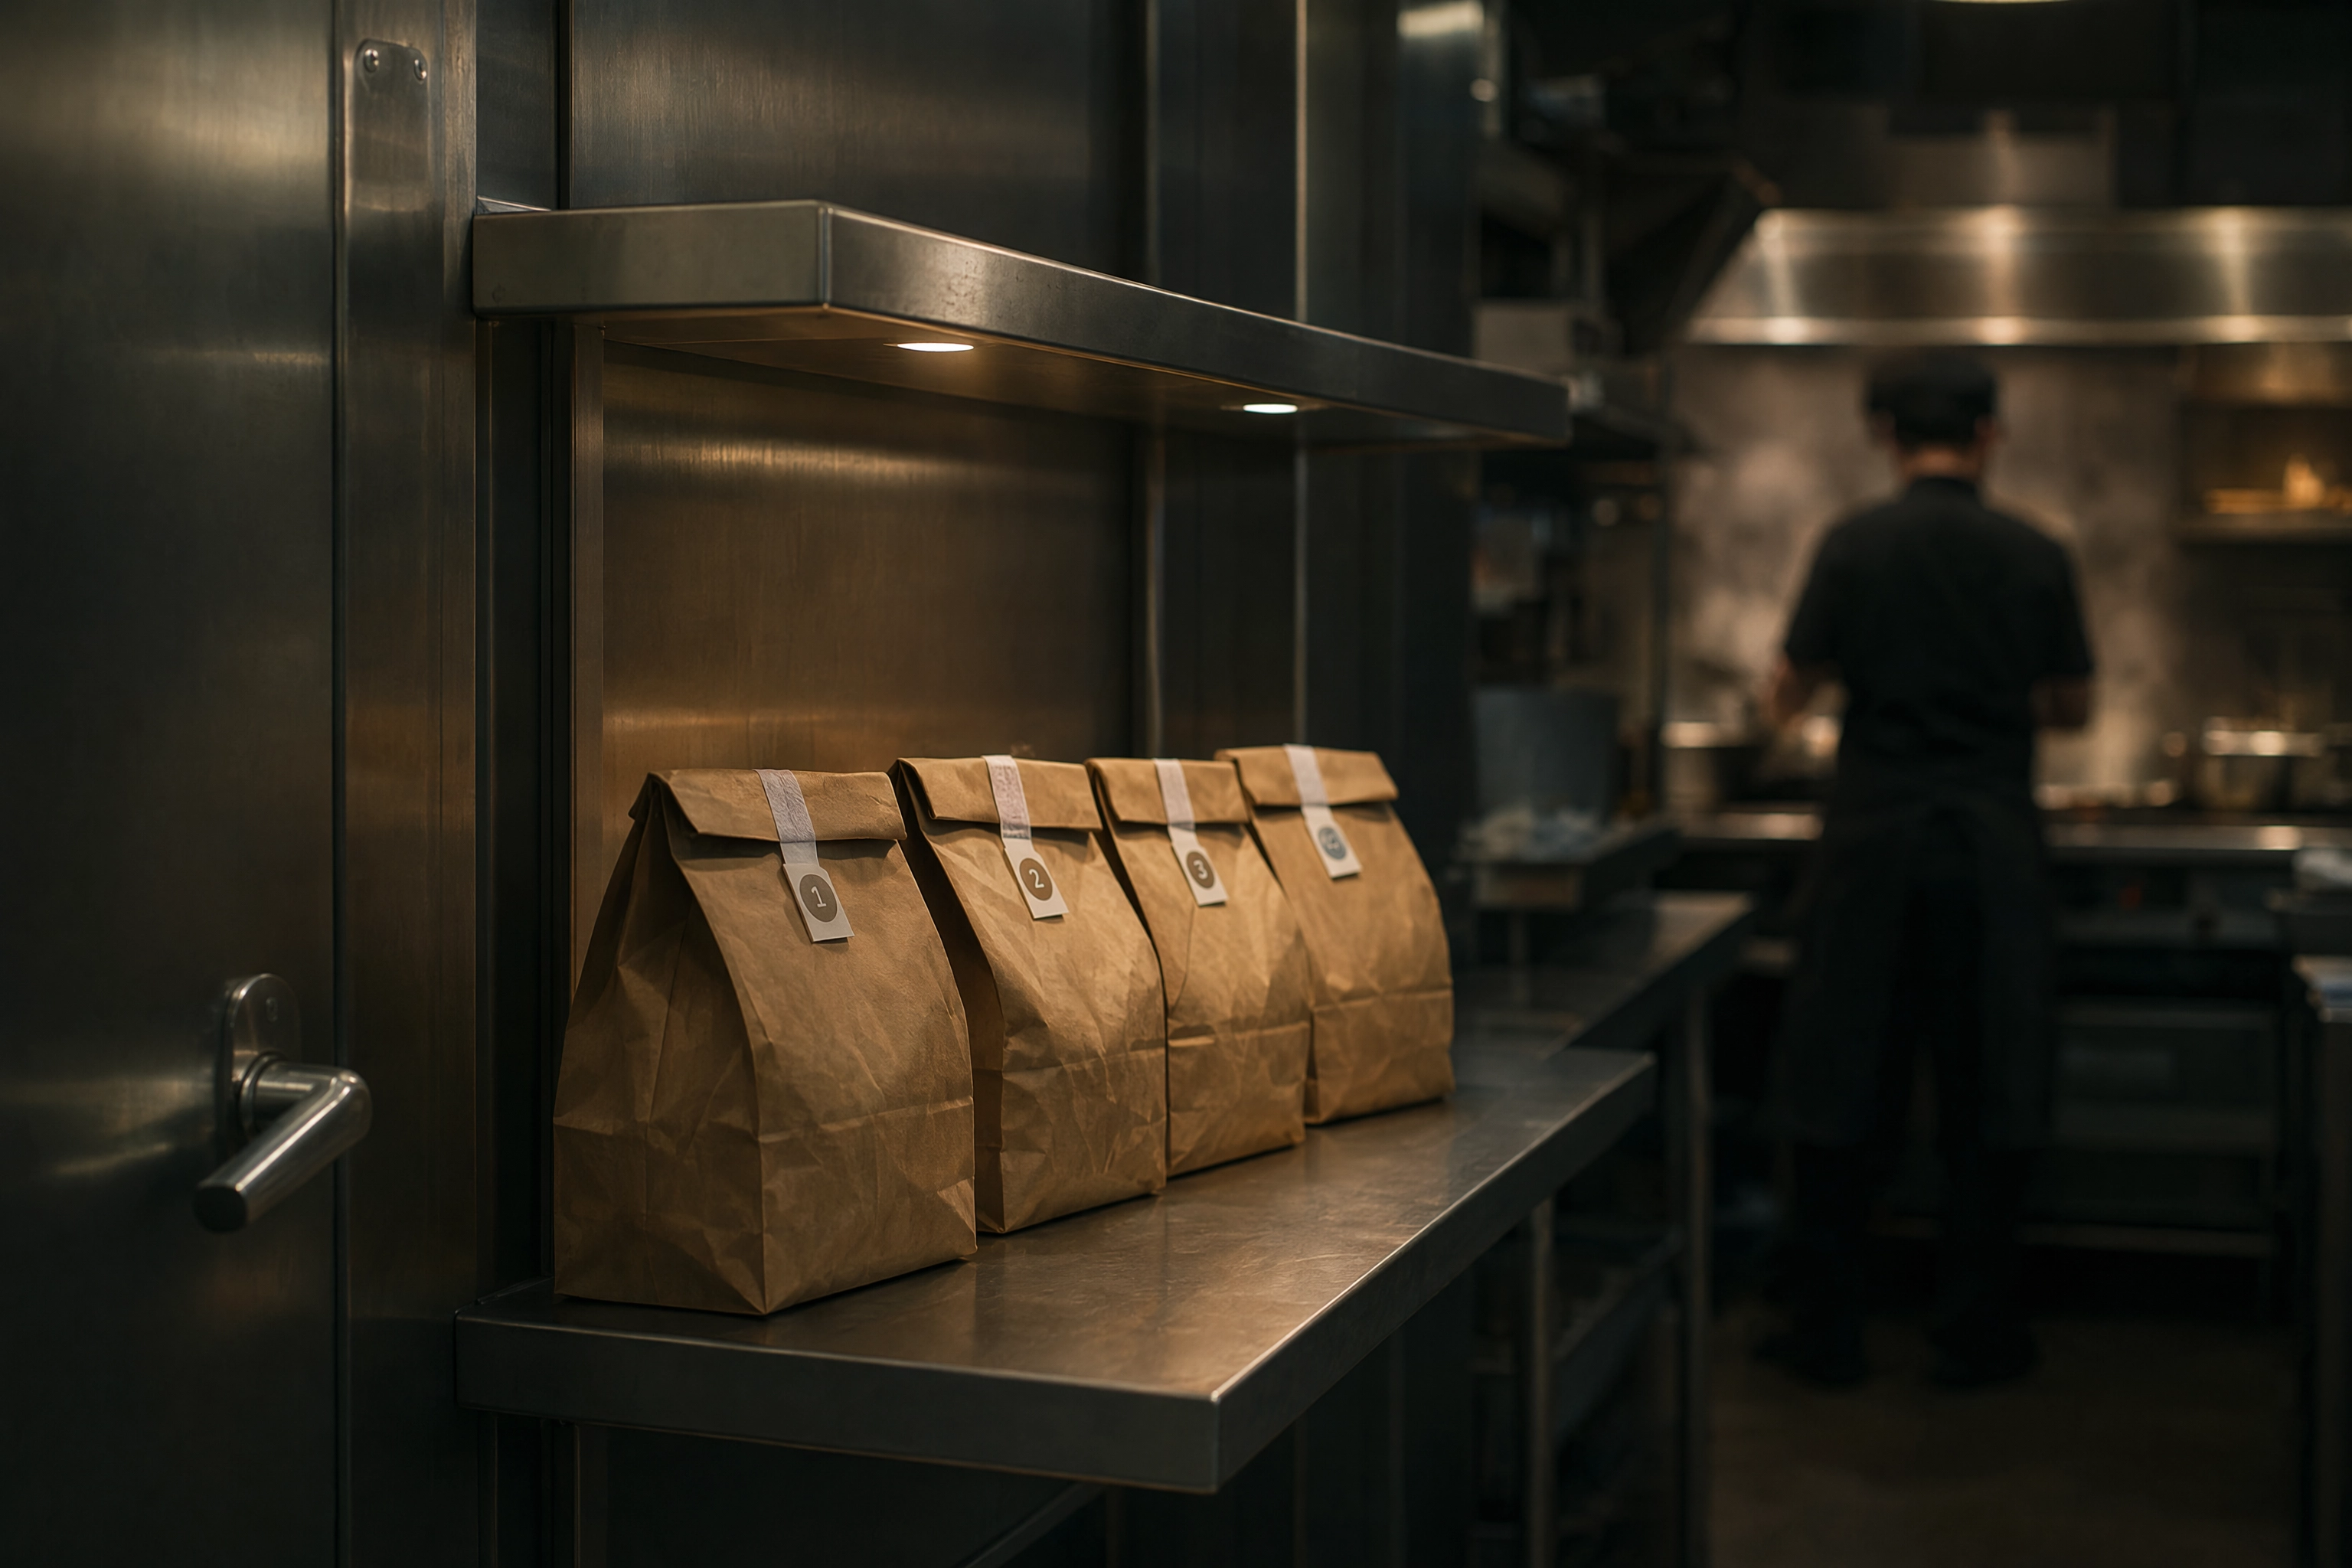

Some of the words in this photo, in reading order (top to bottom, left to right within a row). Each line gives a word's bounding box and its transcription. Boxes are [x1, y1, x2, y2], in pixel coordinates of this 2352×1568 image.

[1029, 868, 1044, 888] 2
[1194, 860, 1208, 880] 3
[811, 886, 827, 907] 1
